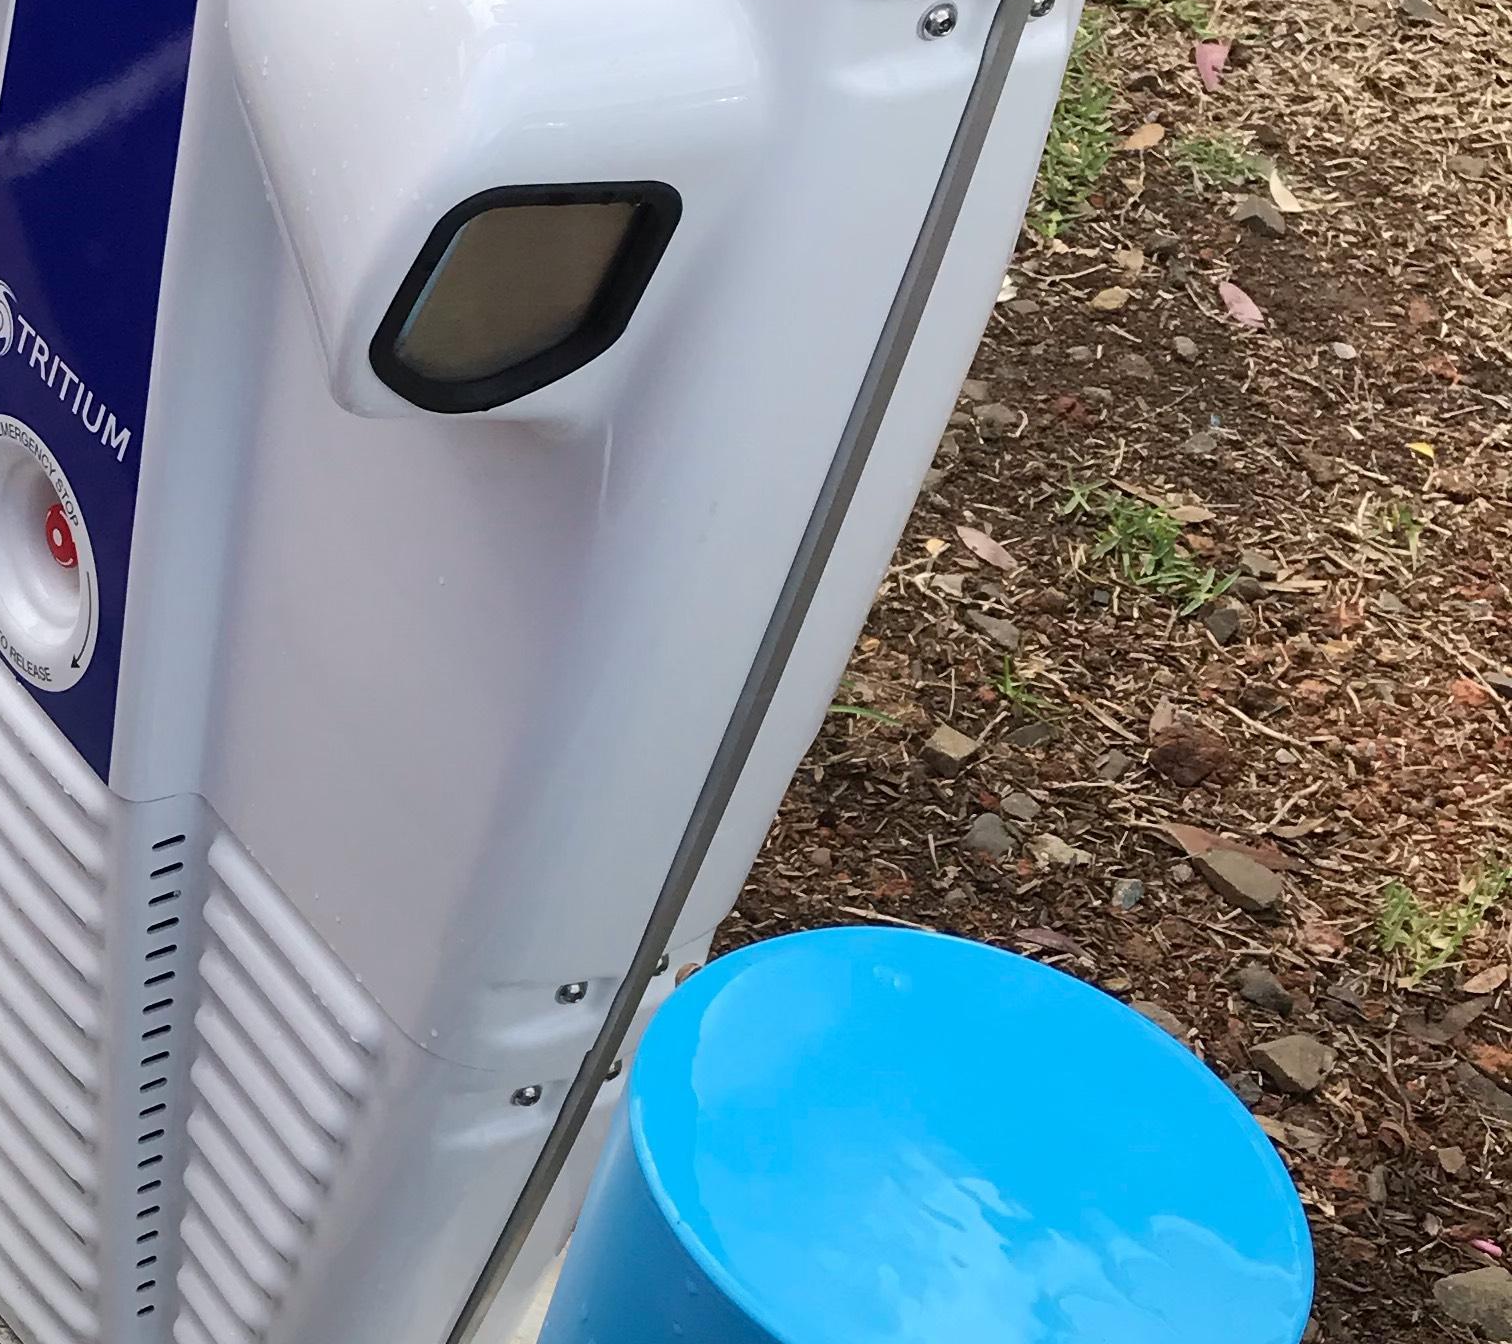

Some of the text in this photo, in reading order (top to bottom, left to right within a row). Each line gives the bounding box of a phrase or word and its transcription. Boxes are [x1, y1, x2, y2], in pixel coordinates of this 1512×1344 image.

[16, 314, 132, 463] TRITIUM
[55, 477, 80, 528] STOP
[8, 644, 53, 684] RELEASE
